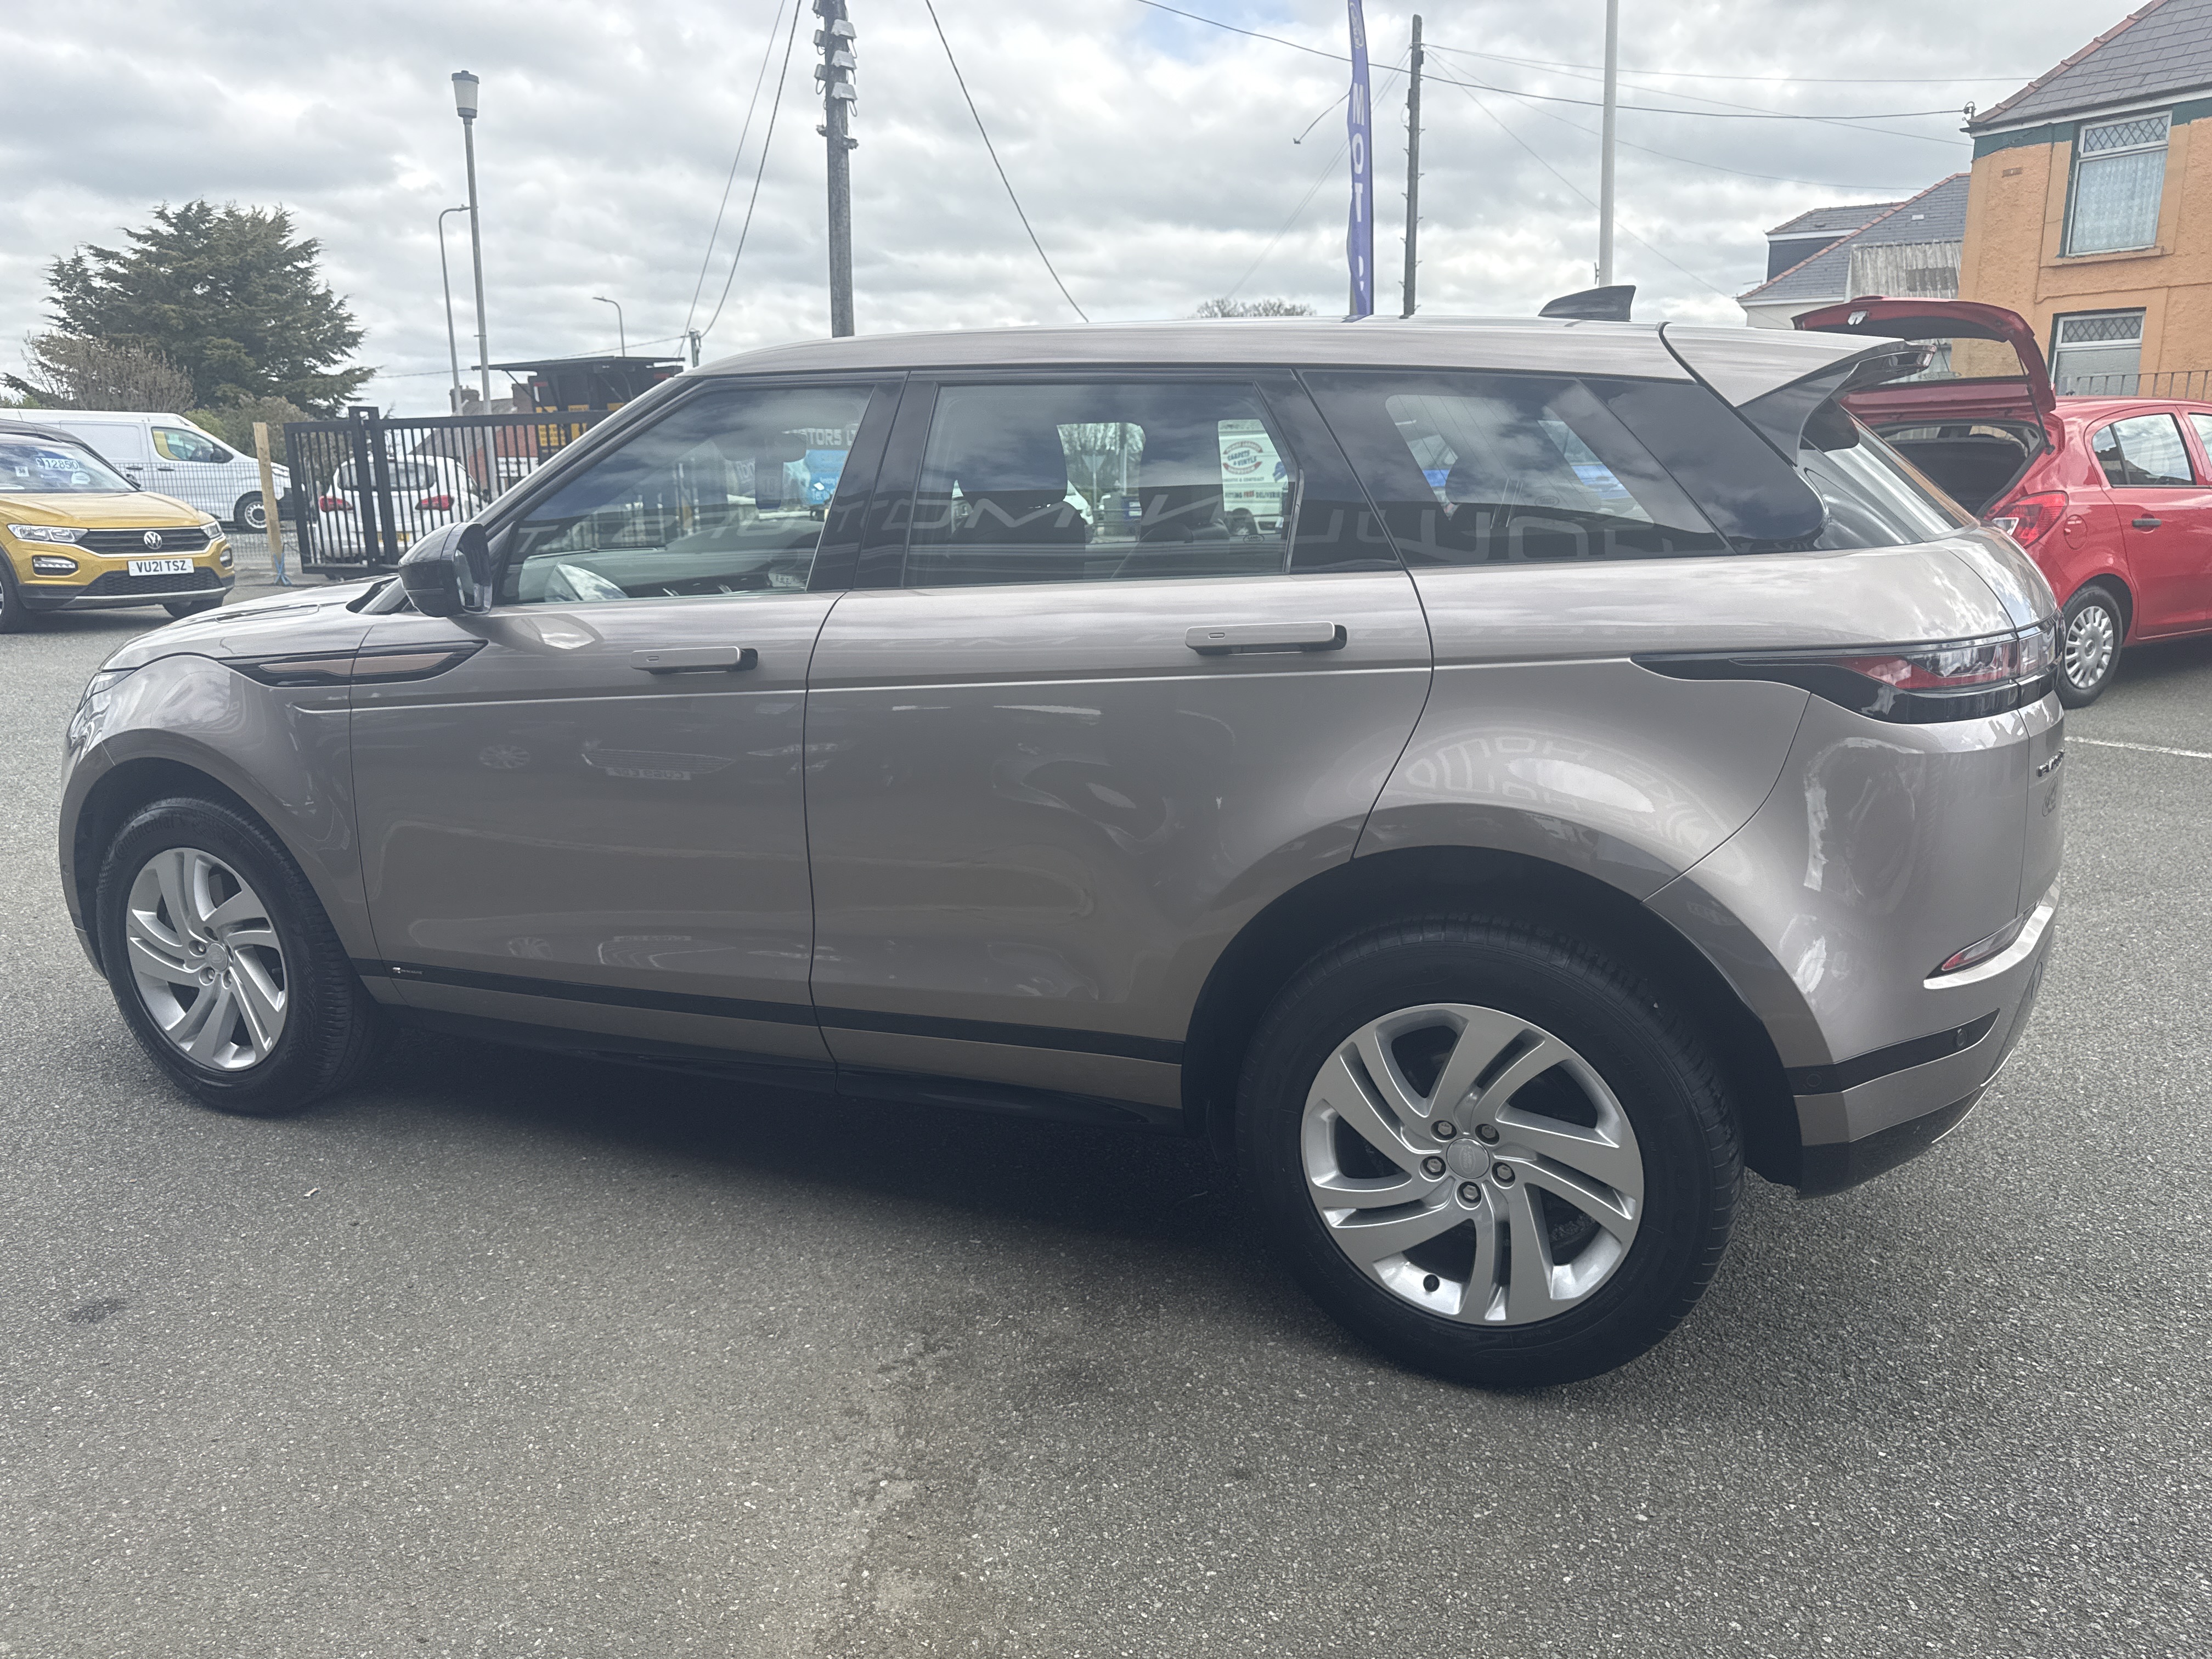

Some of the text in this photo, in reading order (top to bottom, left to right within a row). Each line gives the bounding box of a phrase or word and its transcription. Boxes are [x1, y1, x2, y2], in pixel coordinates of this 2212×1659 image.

[788, 428, 842, 445] TORS
[136, 560, 187, 573] VU21 TSZ
